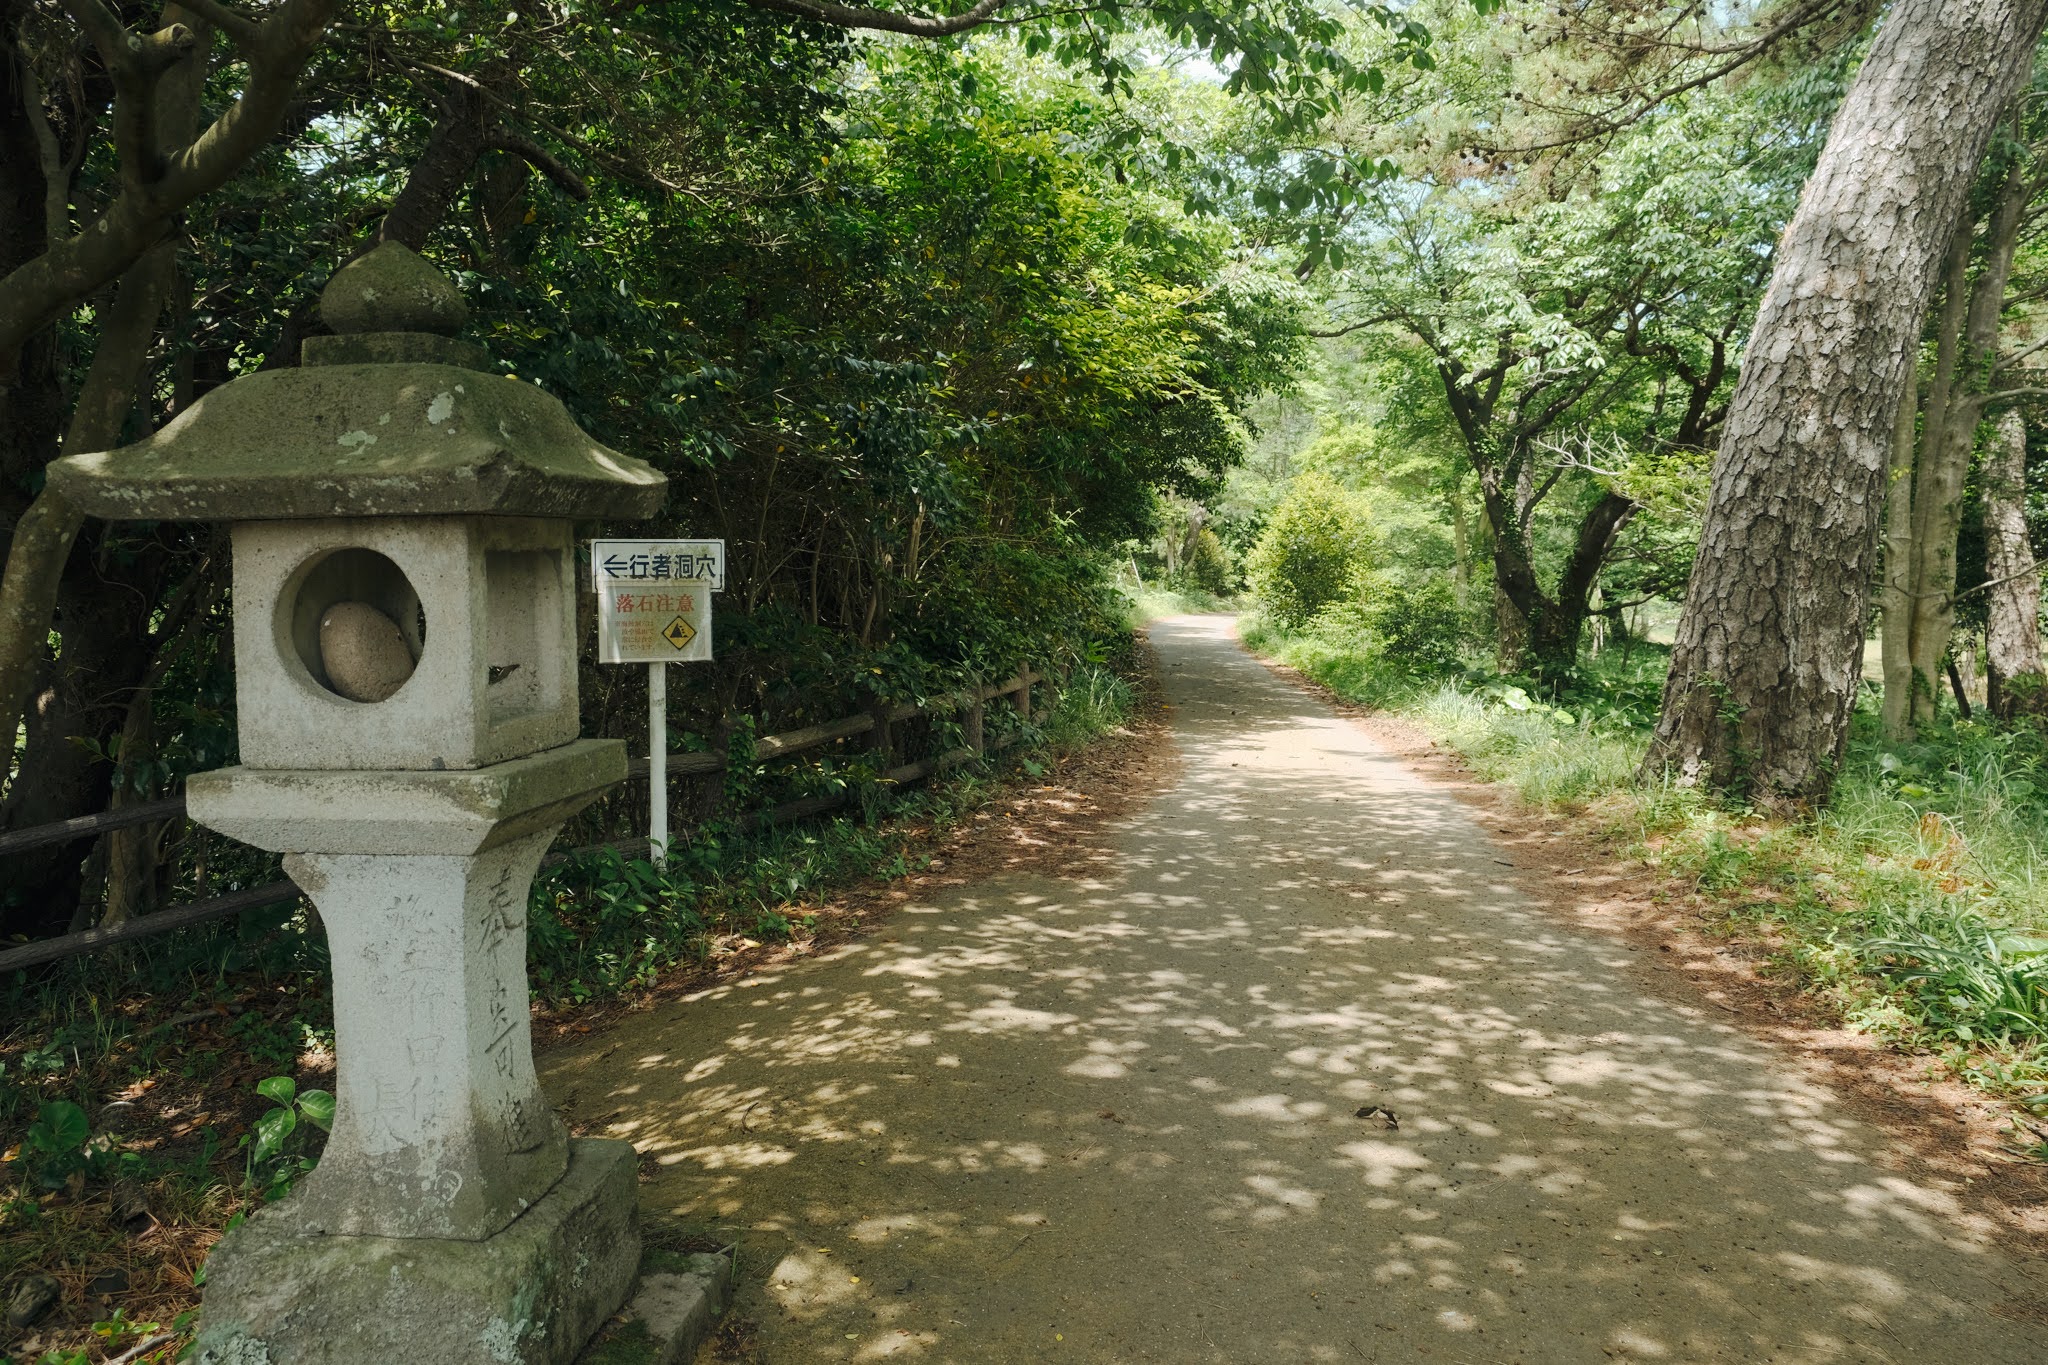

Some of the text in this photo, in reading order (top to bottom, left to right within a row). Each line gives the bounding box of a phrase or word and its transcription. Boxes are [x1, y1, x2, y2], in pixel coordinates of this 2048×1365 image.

[629, 554, 716, 579] 行者洞穴
[616, 594, 695, 613] 落石注意
